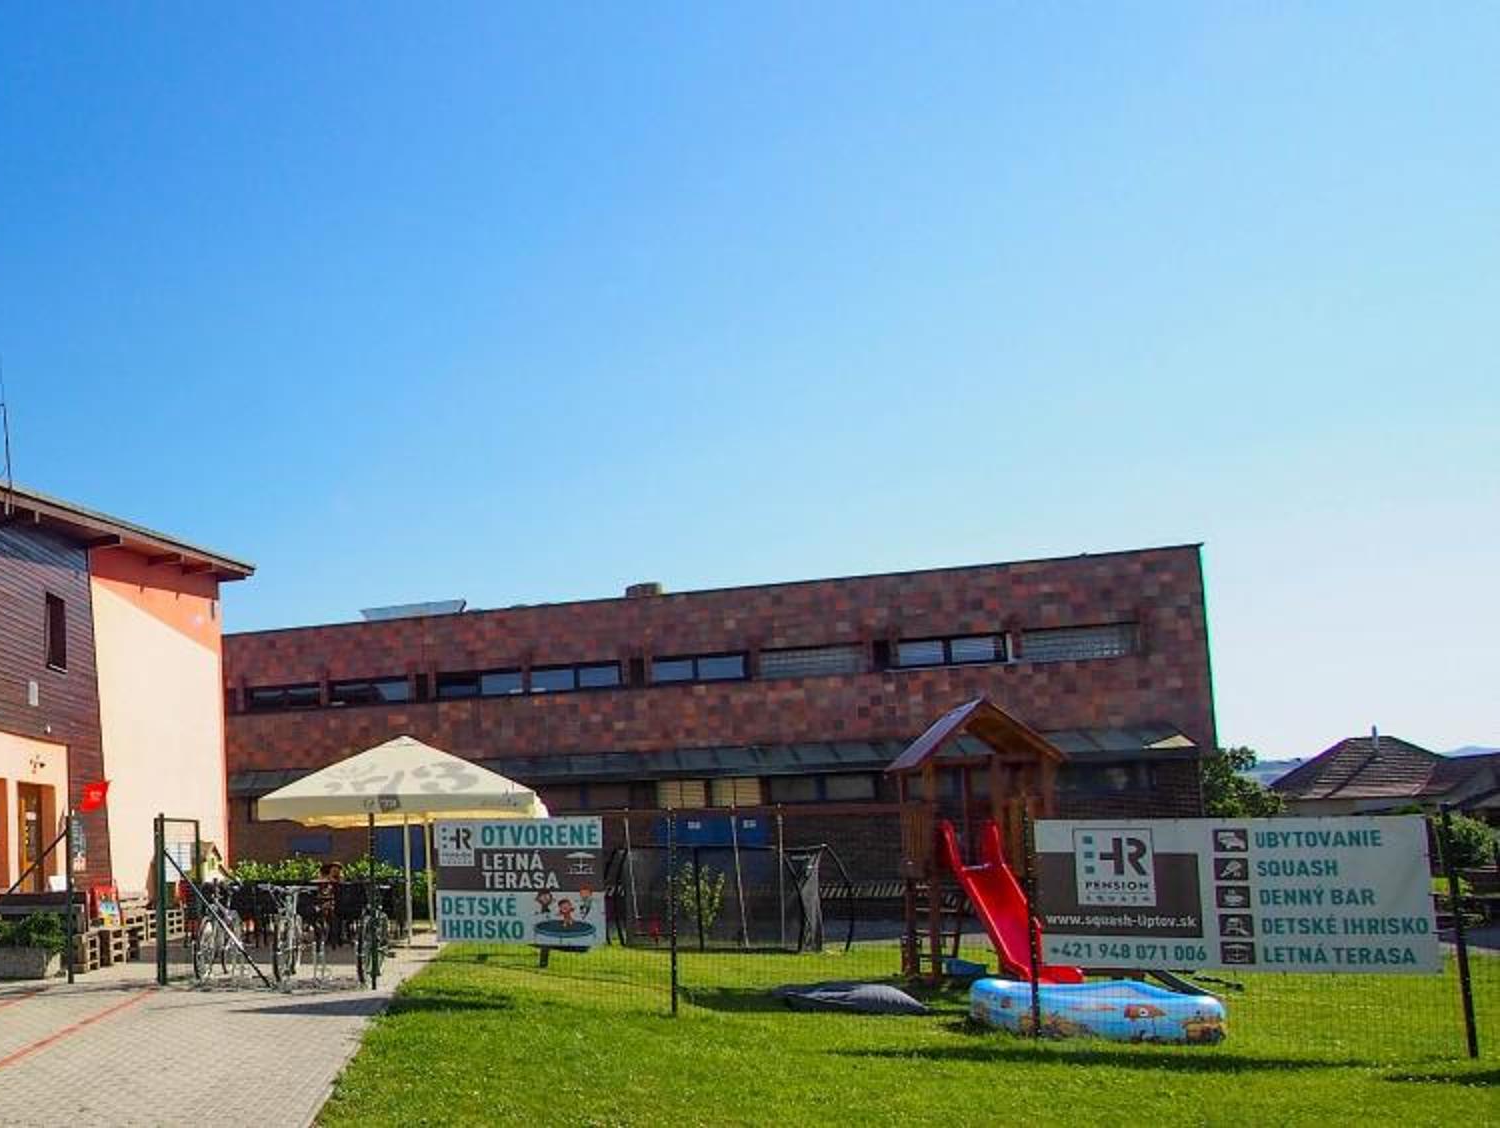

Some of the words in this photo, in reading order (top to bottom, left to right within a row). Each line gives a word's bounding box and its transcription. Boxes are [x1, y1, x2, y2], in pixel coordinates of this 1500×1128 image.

[481, 820, 598, 846] OTVORENÉ
[1254, 829, 1382, 848] UBYTOVANIE
[481, 851, 544, 870] LETNÁ
[1256, 859, 1339, 877] SQUASH
[481, 871, 560, 889] TERASA
[441, 893, 517, 916] DETSKÉ
[1259, 884, 1325, 906] DENNÝ
[1331, 889, 1376, 905] BAR
[441, 919, 524, 940] IHRISKO
[1045, 914, 1198, 929] www.squash-liptov.sk
[1261, 914, 1337, 935] DETSKÉ
[1343, 917, 1429, 935] IHRISKO
[1051, 942, 1092, 958] +421
[1099, 943, 1131, 959] 948
[1136, 945, 1168, 960] 071
[1174, 945, 1208, 962] 006
[1263, 943, 1328, 963] LETNÁ
[1331, 947, 1417, 965] TERASA
